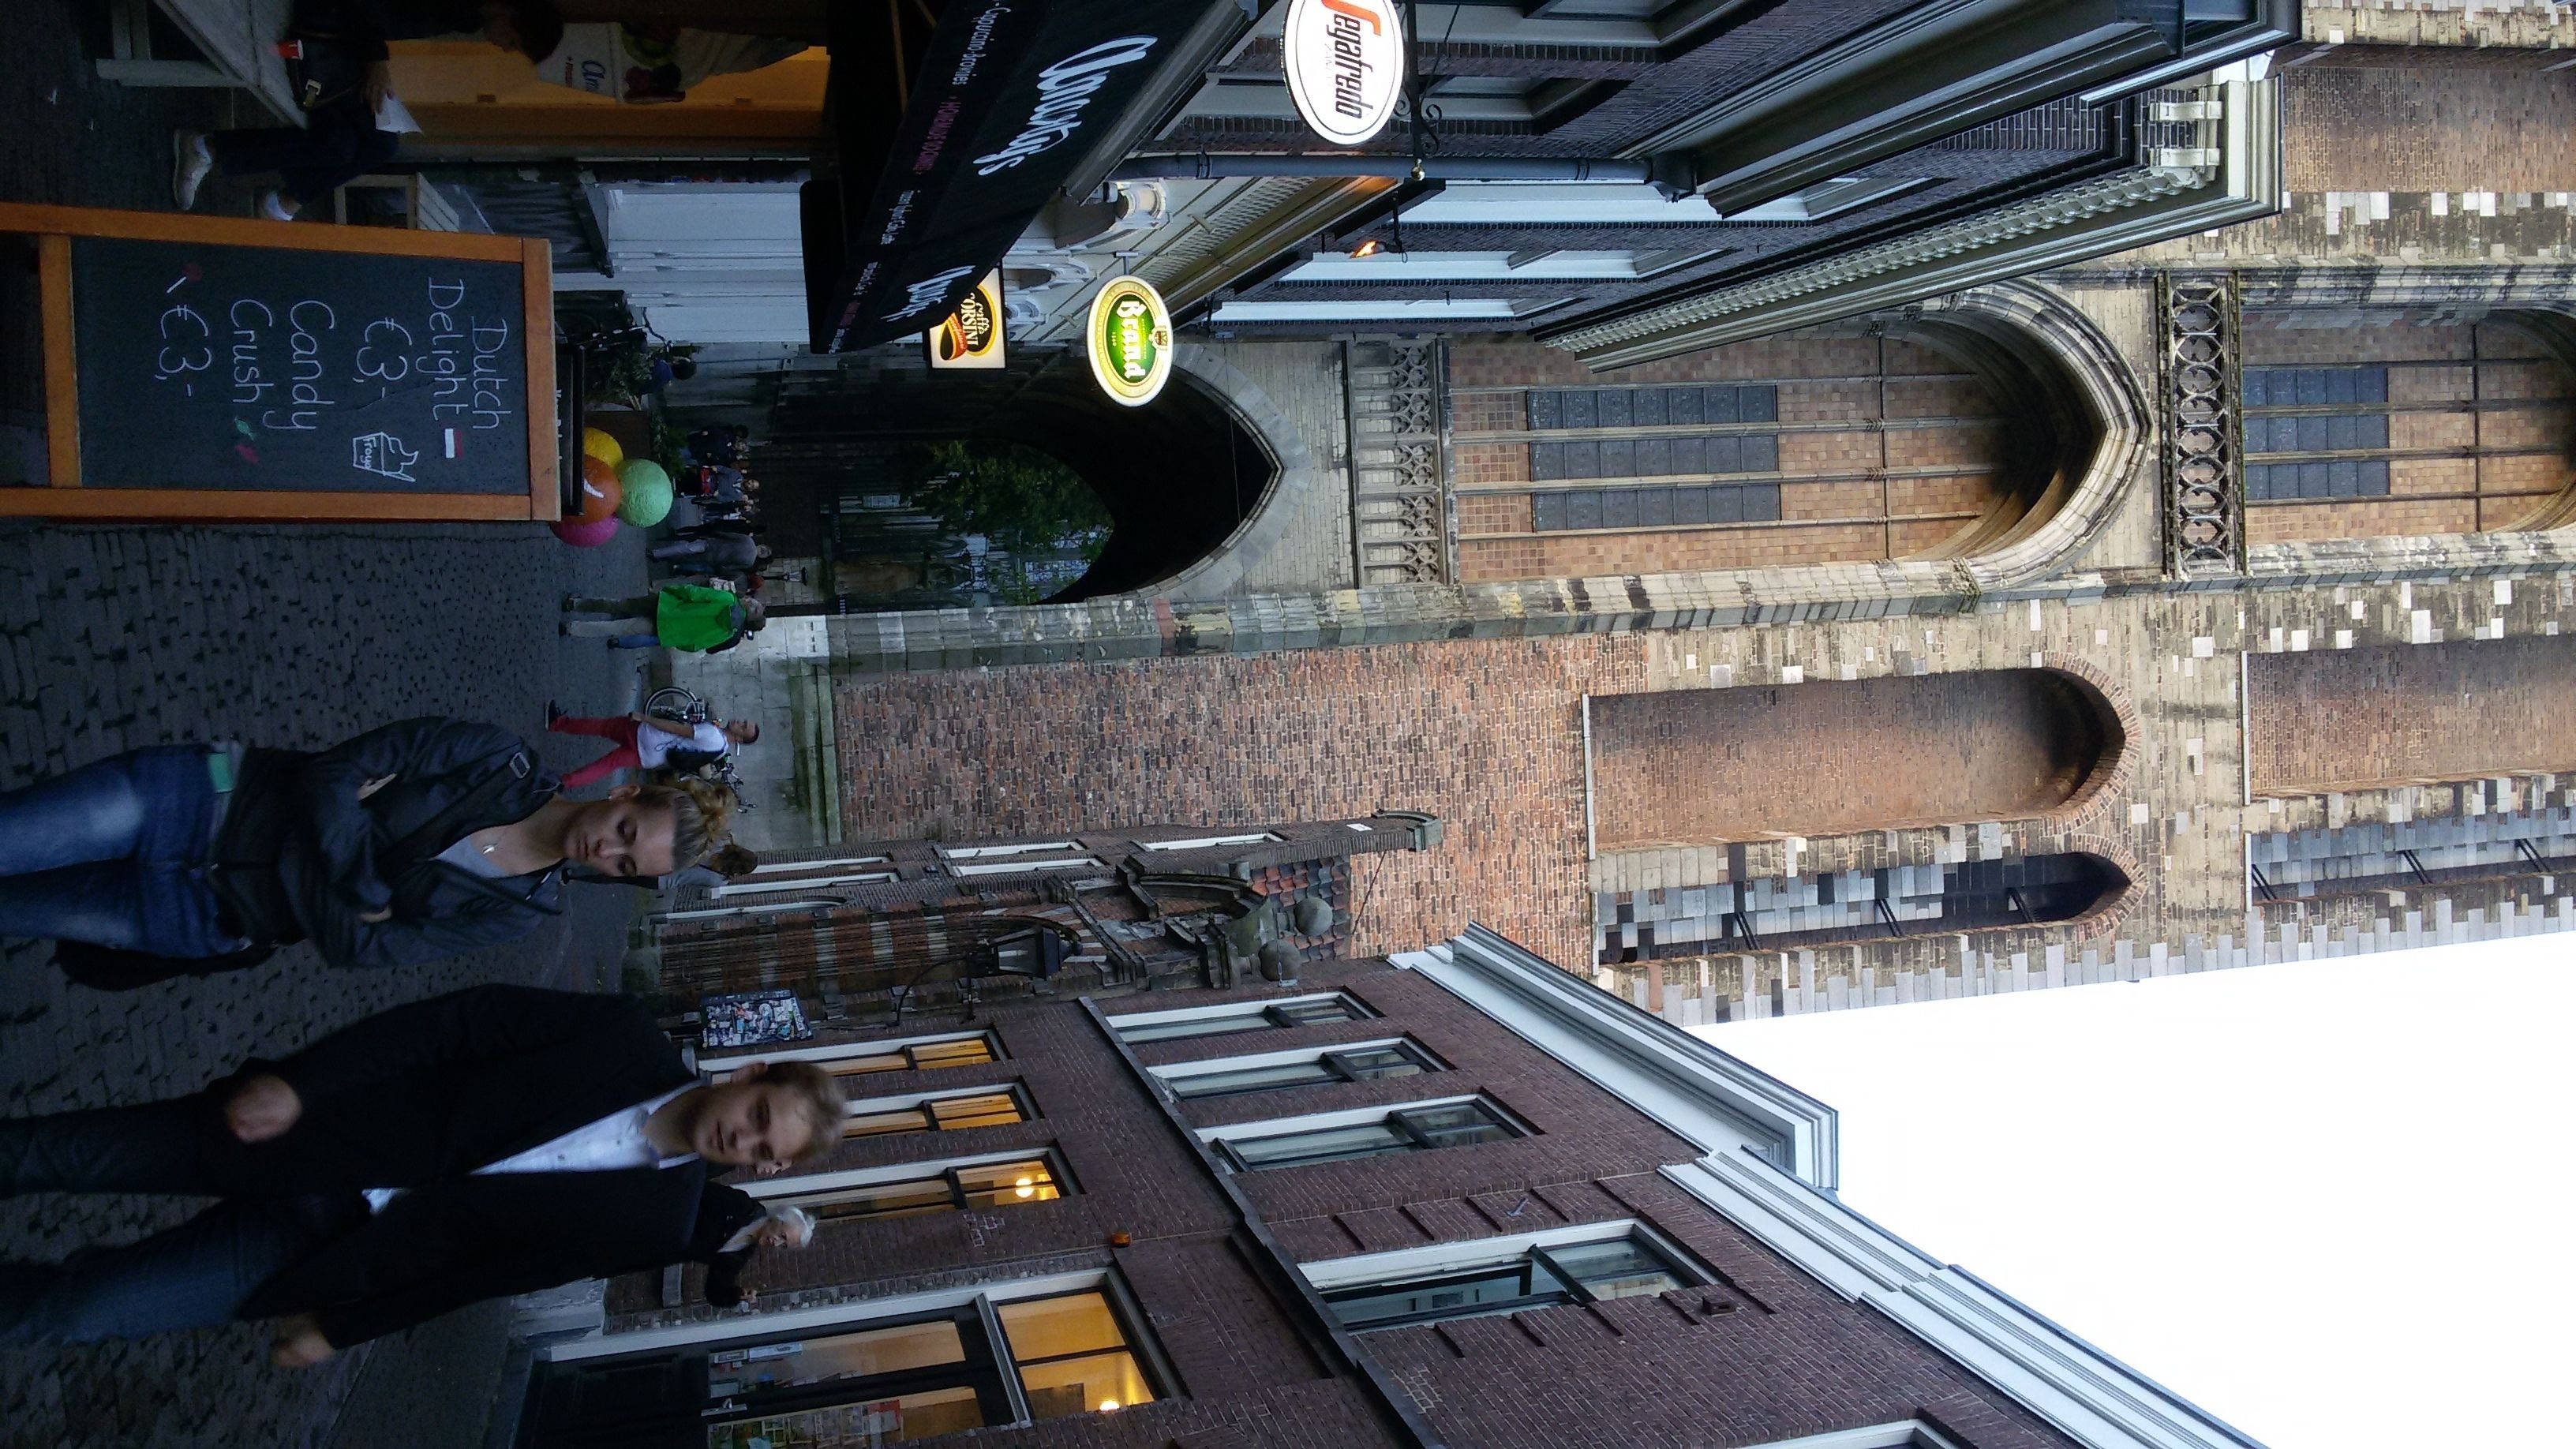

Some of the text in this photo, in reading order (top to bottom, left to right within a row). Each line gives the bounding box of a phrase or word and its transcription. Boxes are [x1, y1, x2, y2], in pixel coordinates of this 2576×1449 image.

[154, 303, 212, 397] €3,-
[230, 298, 275, 403] Crush
[262, 299, 335, 429] Candy
[353, 316, 413, 399] €3,-
[415, 277, 469, 421] Delight
[471, 316, 511, 429] Dutch
[1116, 301, 1147, 379] Brand
[359, 436, 377, 469] Froyo
